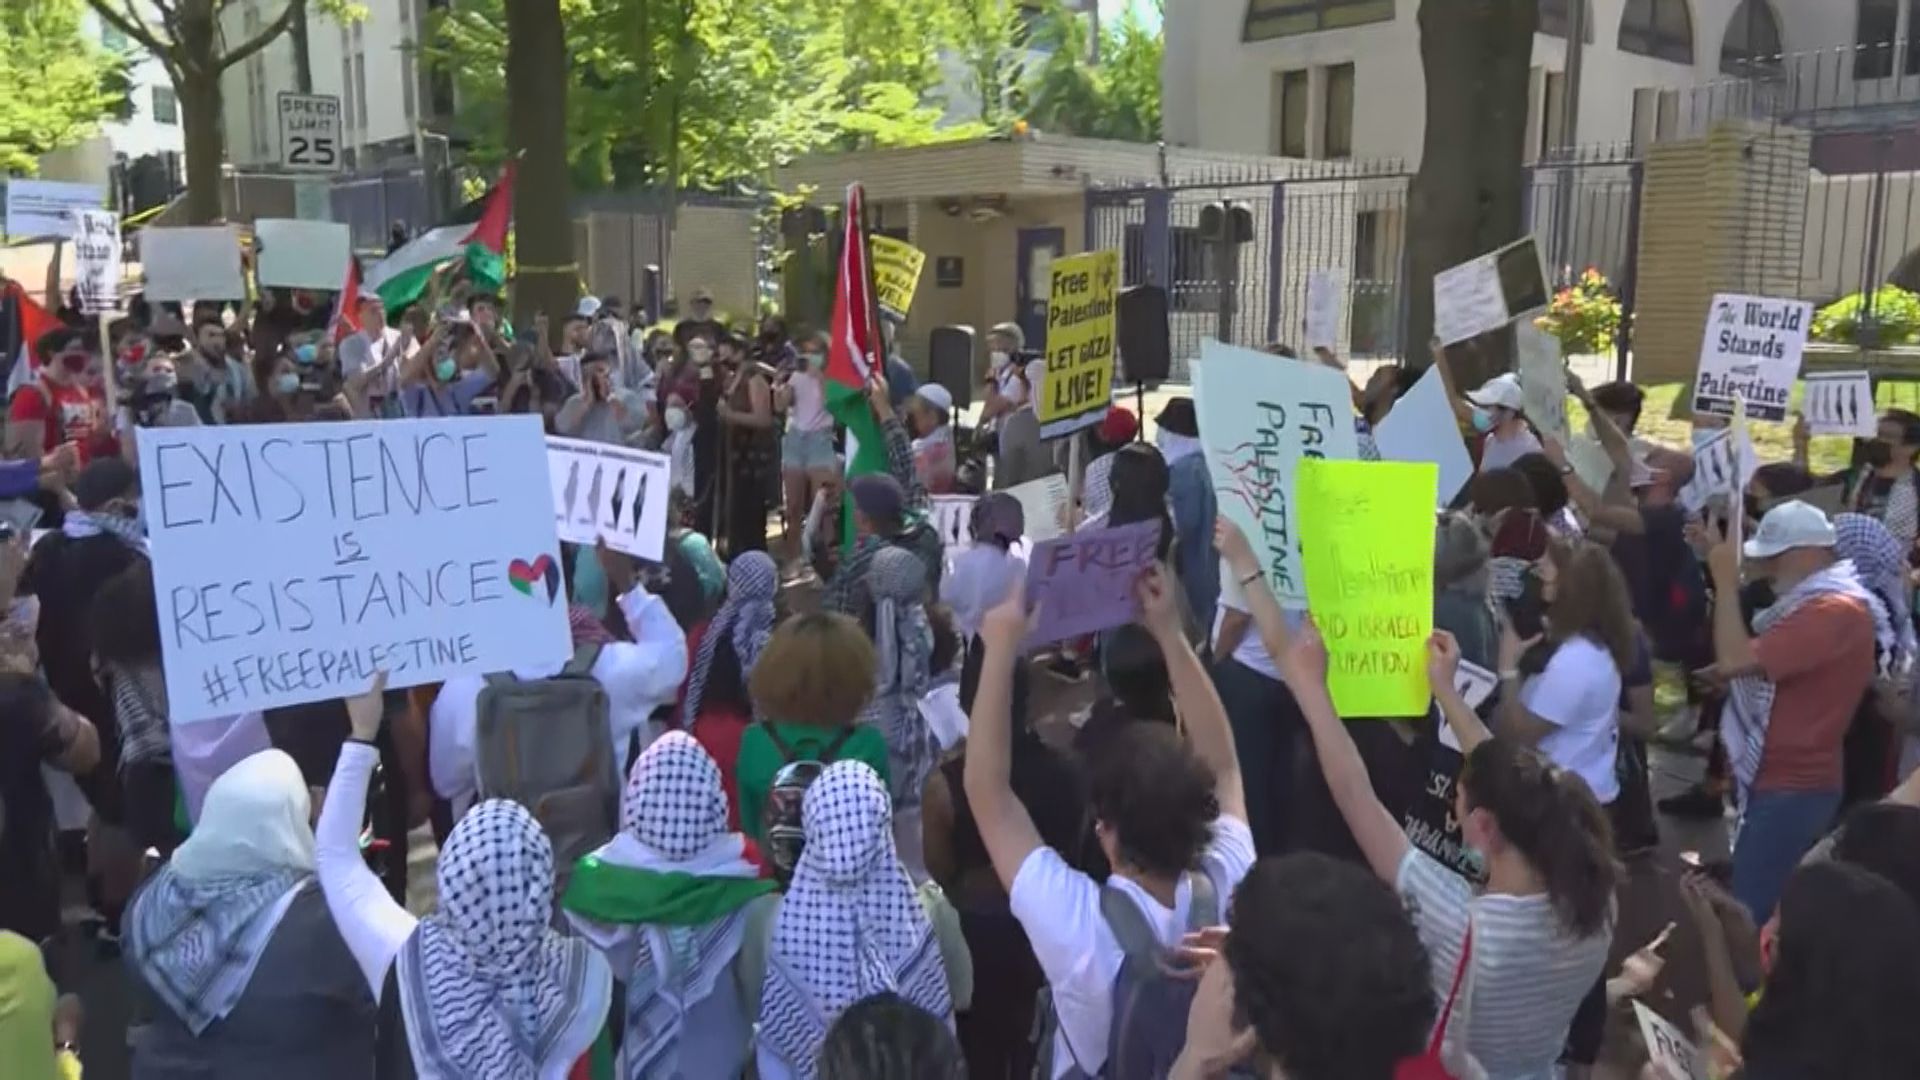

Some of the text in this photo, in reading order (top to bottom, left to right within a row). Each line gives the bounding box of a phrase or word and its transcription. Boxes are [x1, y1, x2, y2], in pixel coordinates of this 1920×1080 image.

[282, 98, 336, 114] SPEED
[289, 136, 335, 165] 25
[1052, 271, 1089, 297] Free
[1050, 299, 1112, 329] Palestine
[1744, 303, 1803, 332] World
[1048, 334, 1111, 373] LET GAZA
[1717, 330, 1785, 359] Stands
[1055, 369, 1103, 410] LIVE!
[1699, 372, 1788, 404] Palestine
[157, 433, 499, 529] EXISTENCE
[1256, 402, 1294, 593] PALESTINE
[333, 531, 366, 561] IS
[1045, 527, 1158, 577] FREE
[171, 559, 503, 649] RESISTANCE
[202, 634, 479, 707] #FREEPALESTINE
